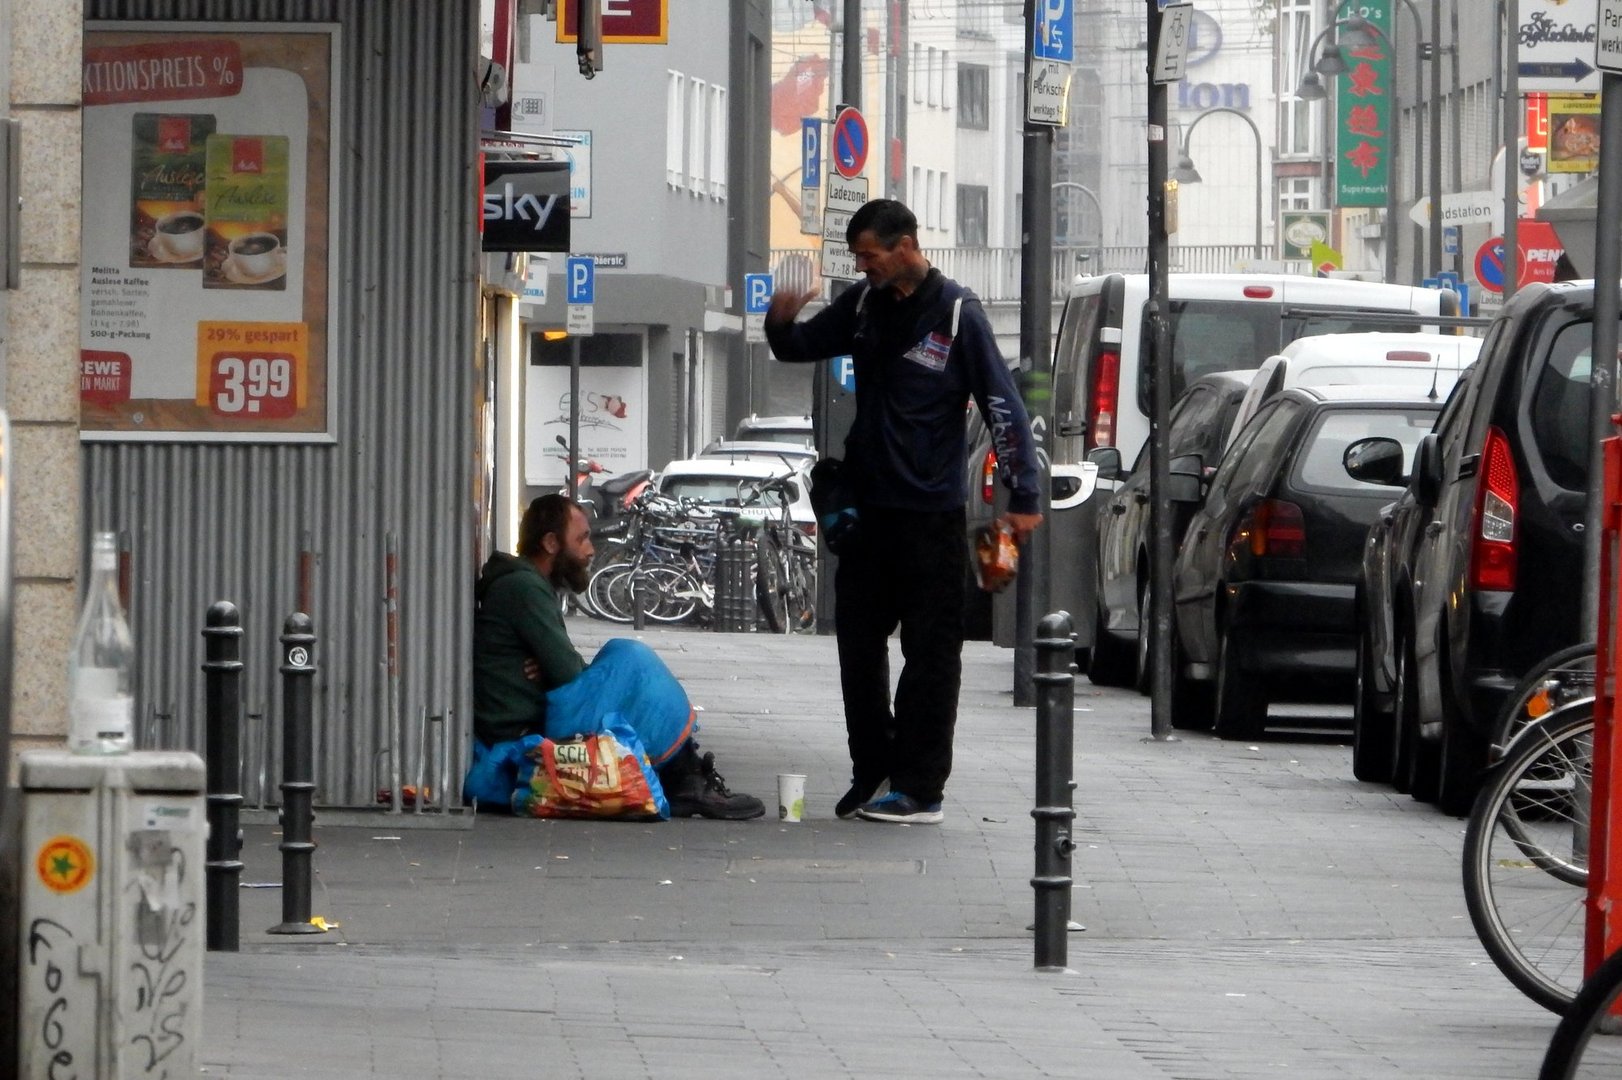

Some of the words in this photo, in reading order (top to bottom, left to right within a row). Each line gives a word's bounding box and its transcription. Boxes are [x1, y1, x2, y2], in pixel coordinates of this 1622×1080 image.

[213, 56, 234, 85] %
[806, 126, 817, 179] P
[484, 182, 559, 231] sky
[829, 183, 866, 204] Ladezone
[123, 278, 150, 286] Kaffee
[573, 264, 588, 299] P
[751, 279, 767, 308] P
[207, 328, 241, 342] 29%
[245, 328, 299, 345] gespart
[93, 377, 120, 391] MARKT
[217, 357, 290, 413] 3.99
